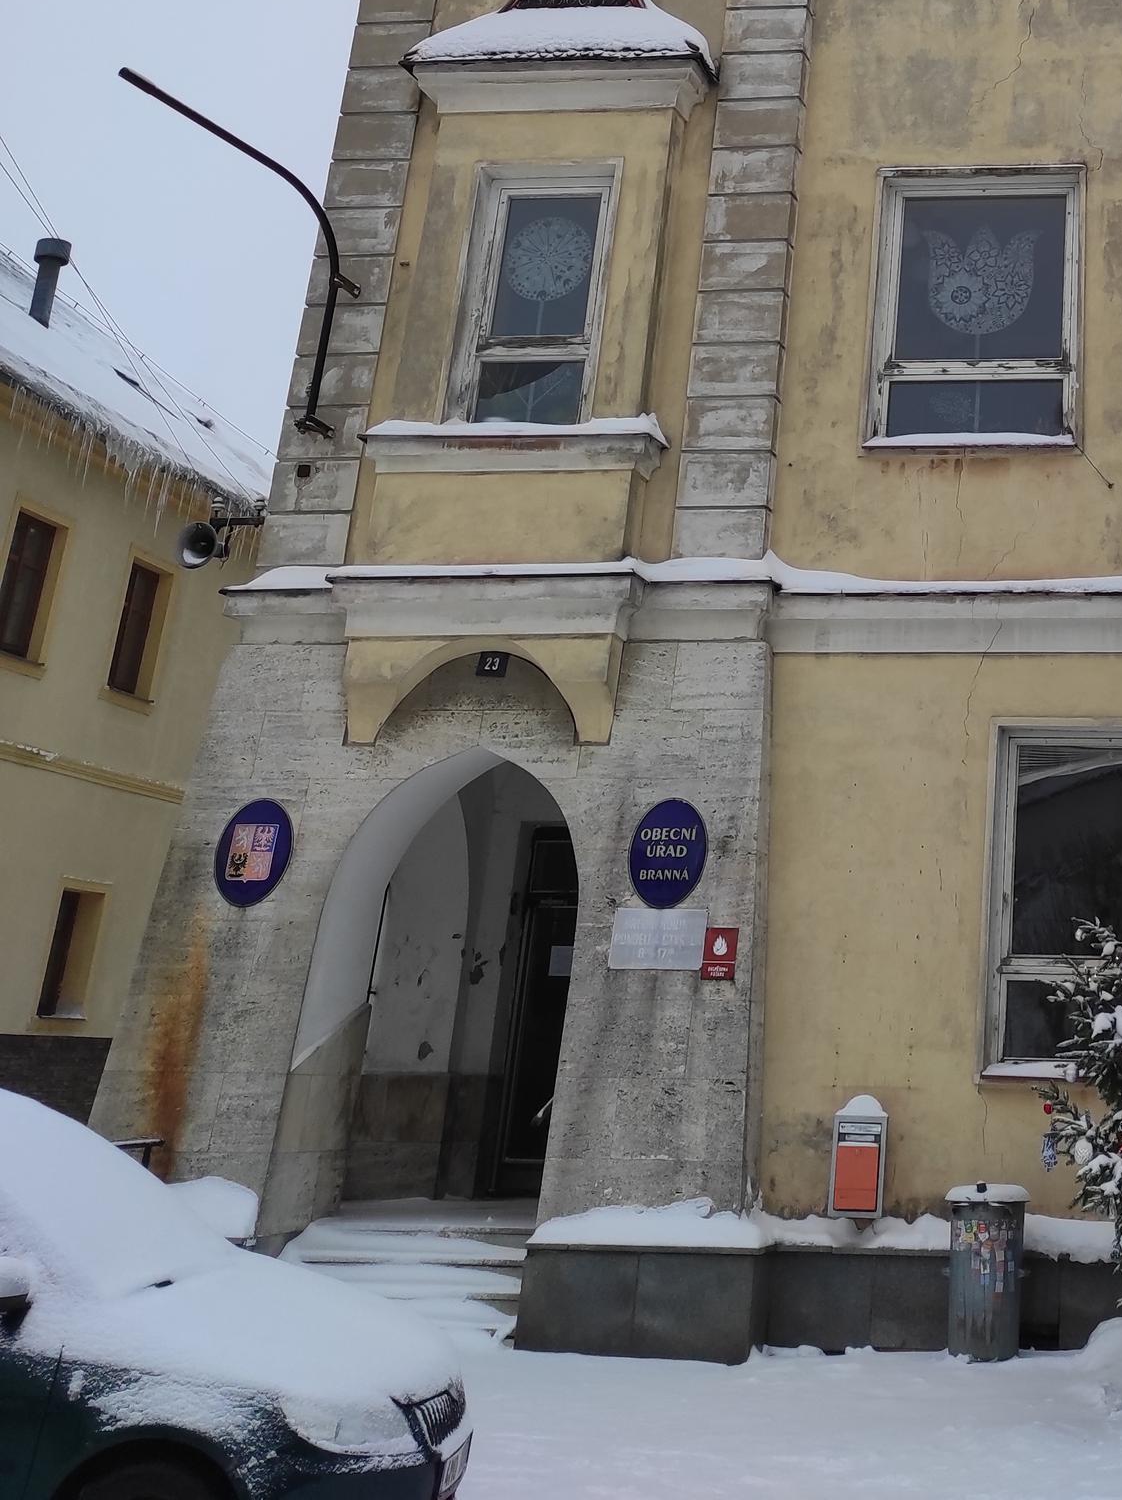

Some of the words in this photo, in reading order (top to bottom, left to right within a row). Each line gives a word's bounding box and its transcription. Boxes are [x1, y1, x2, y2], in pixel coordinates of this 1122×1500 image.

[484, 657, 500, 671] 23
[640, 824, 698, 841] OBECNÍ
[646, 841, 688, 858] ÚŘAD
[639, 866, 689, 881] BRANNÁ
